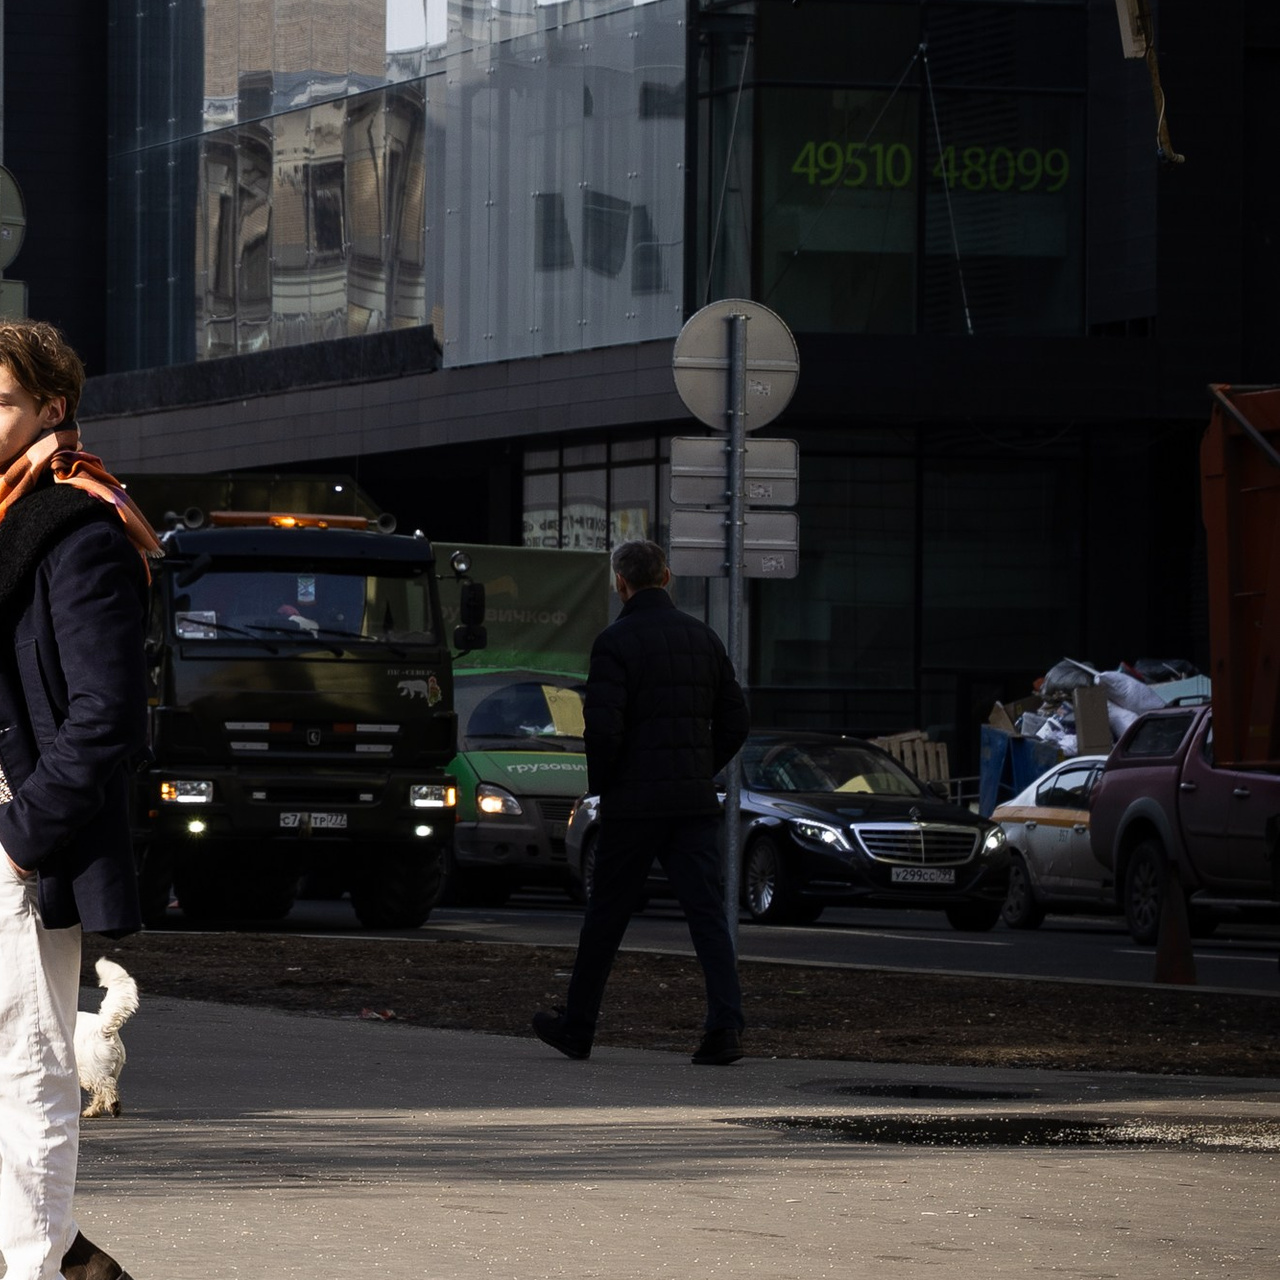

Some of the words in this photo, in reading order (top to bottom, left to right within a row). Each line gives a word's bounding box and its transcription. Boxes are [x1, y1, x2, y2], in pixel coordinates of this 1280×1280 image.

[791, 140, 913, 188] 49510
[932, 145, 1070, 193] 48099
[507, 763, 588, 774] грузови
